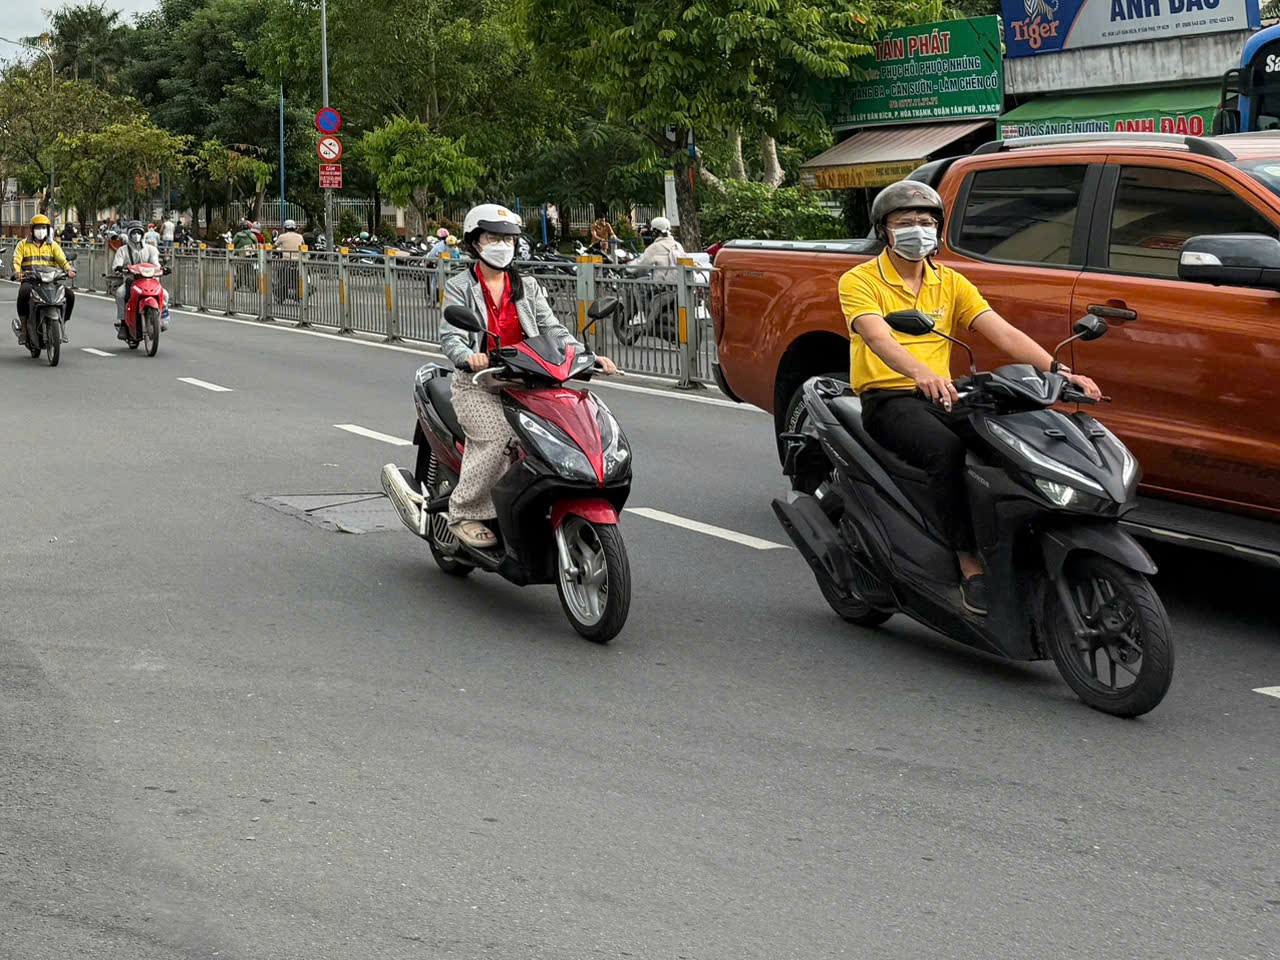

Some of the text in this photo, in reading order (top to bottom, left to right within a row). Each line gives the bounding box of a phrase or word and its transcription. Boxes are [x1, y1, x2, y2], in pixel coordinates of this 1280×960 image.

[873, 28, 950, 61] TẤN PHÁT
[1011, 15, 1060, 49] Tiger
[1114, 118, 1155, 133] ANH
